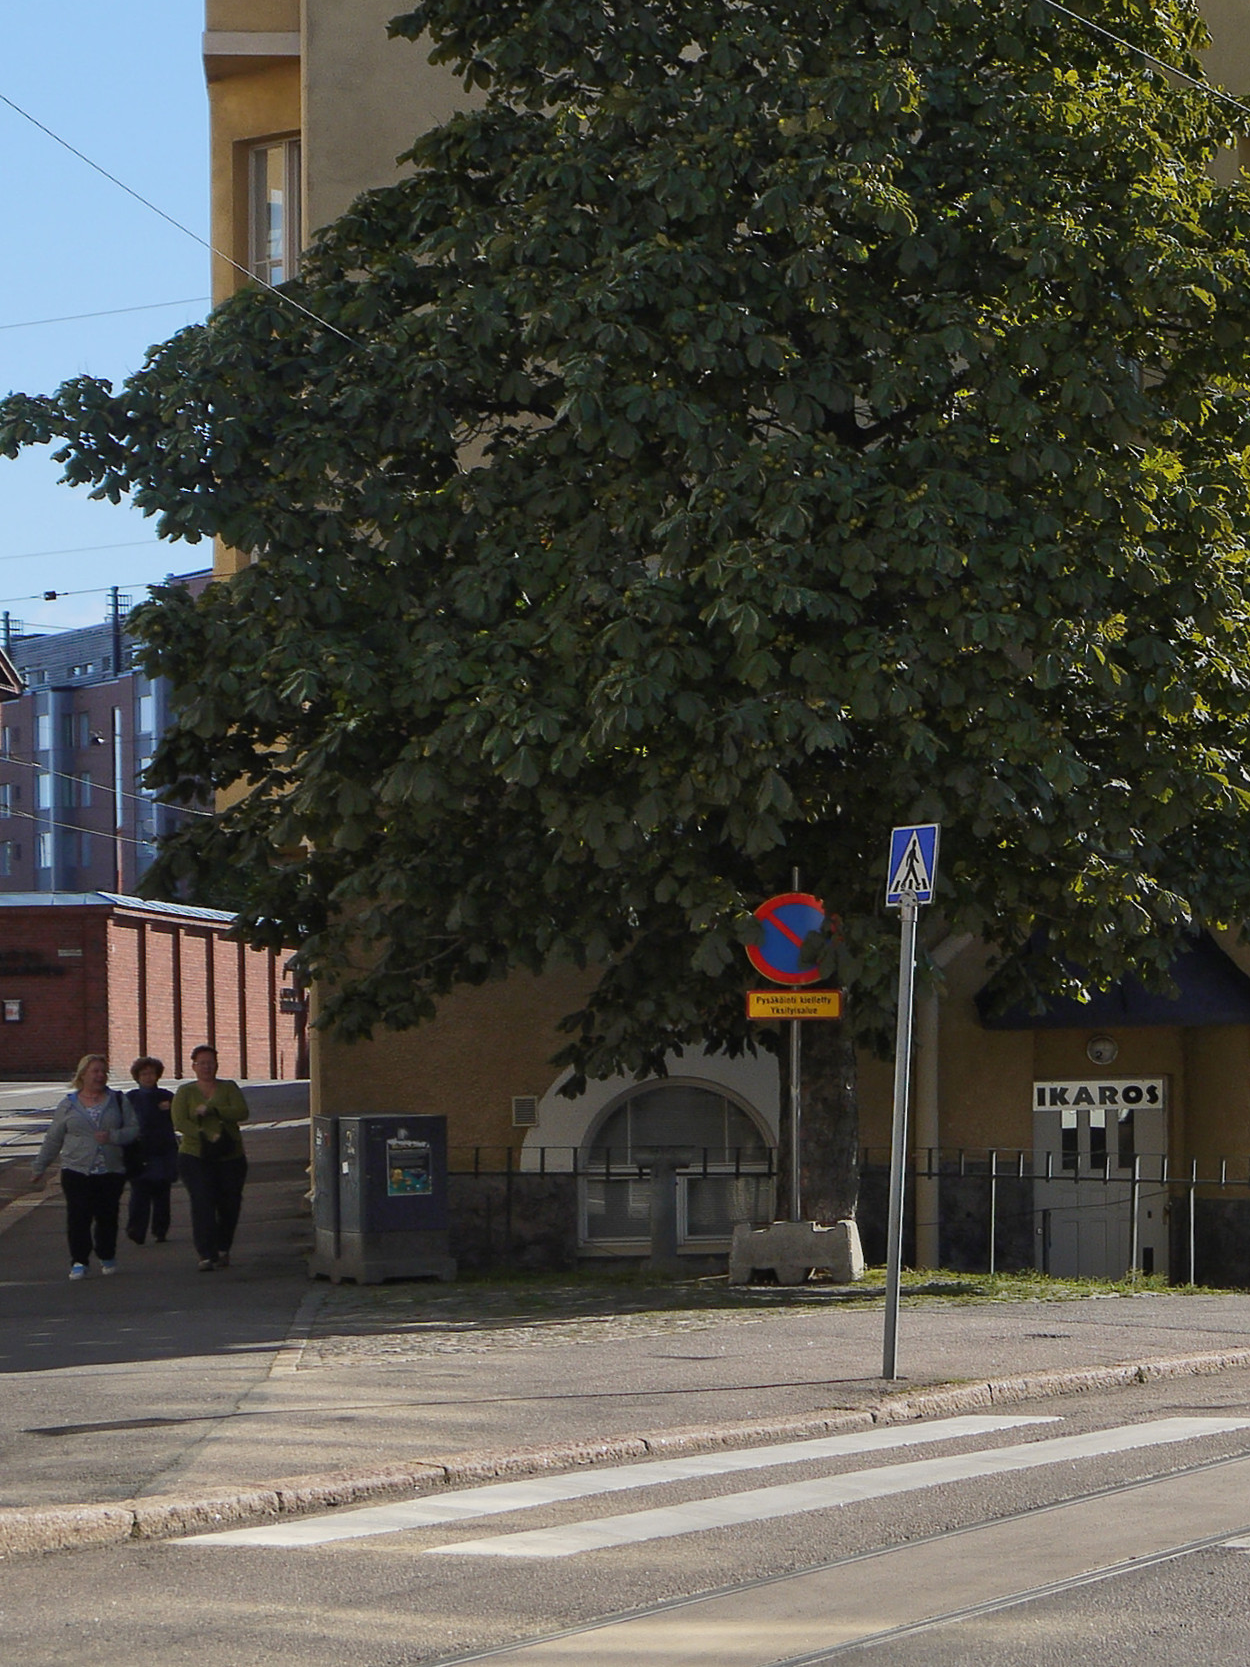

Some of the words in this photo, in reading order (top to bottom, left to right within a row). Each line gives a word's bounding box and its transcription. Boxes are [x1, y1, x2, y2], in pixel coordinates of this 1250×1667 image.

[756, 996, 797, 1005] Pysäköinti
[800, 996, 832, 1005] kielletty
[1036, 1084, 1159, 1107] IKAROS
